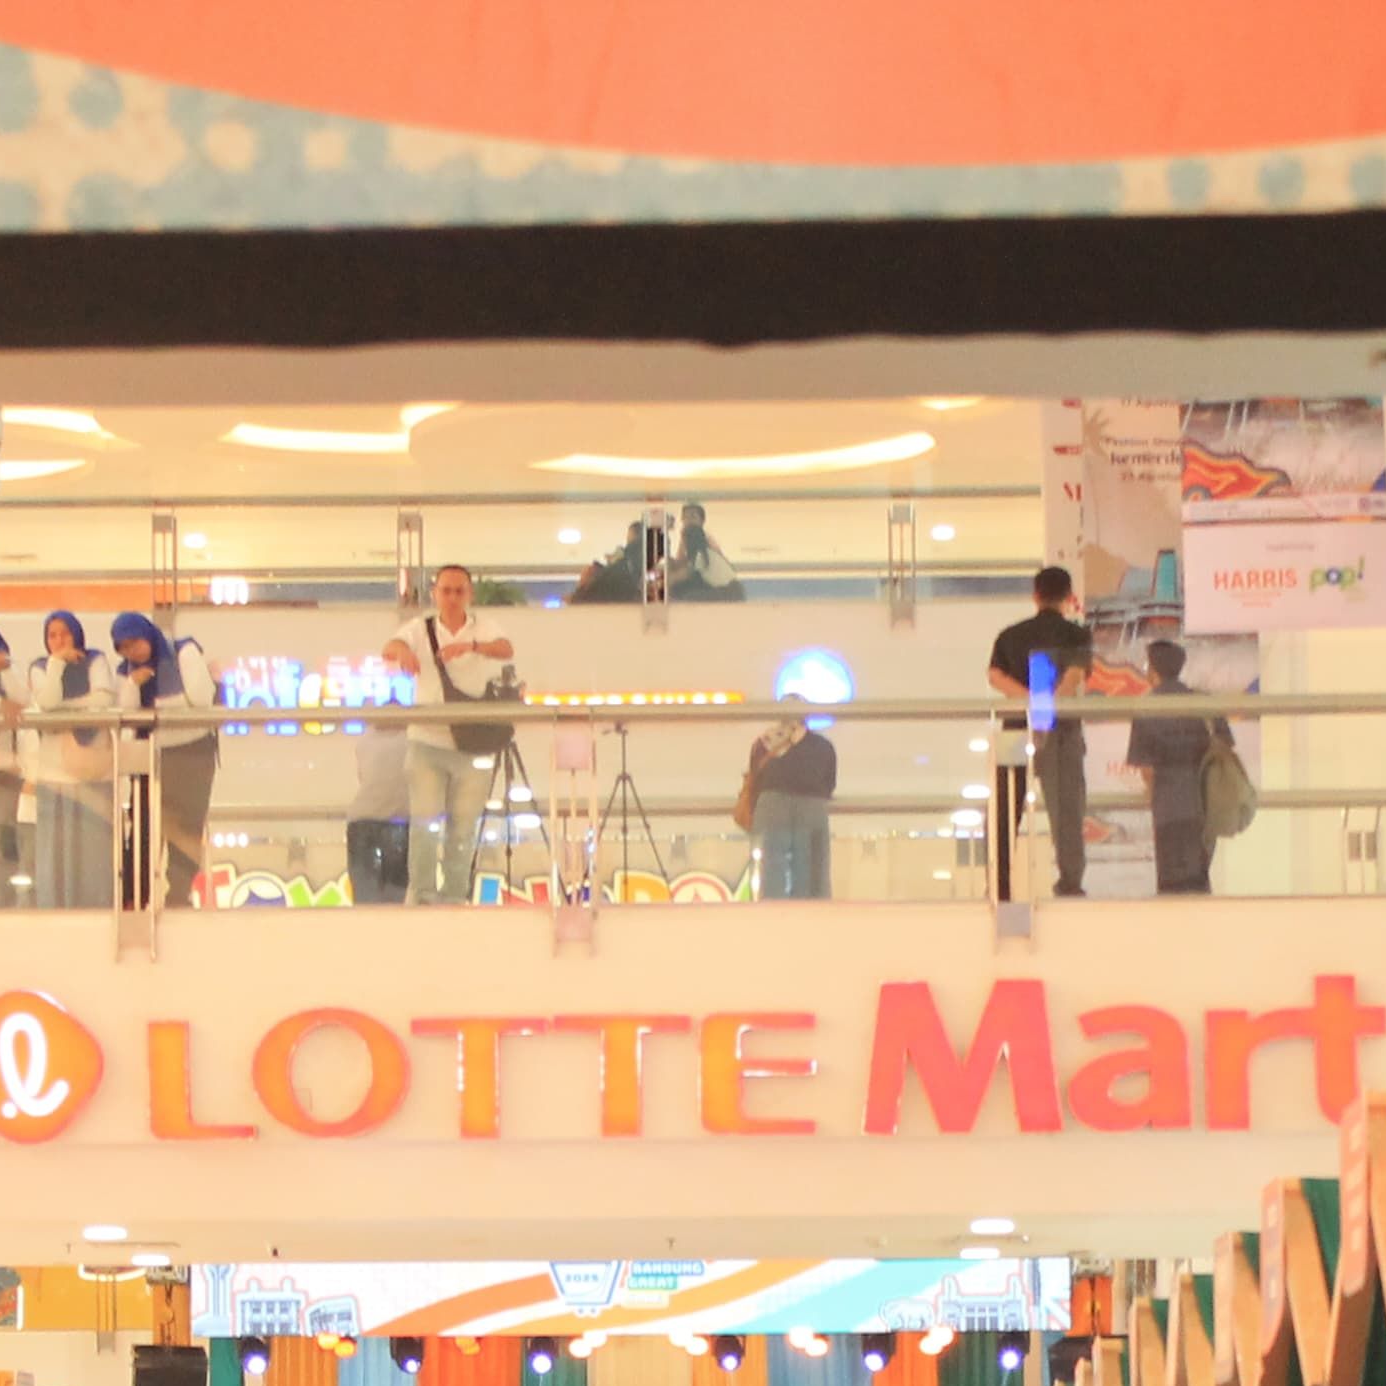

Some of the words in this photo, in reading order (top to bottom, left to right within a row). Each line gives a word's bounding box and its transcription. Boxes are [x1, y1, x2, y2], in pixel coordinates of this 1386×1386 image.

[1213, 567, 1298, 591] HARRIS
[147, 1006, 817, 1139] LOTTE
[861, 974, 1386, 1135] Mart
